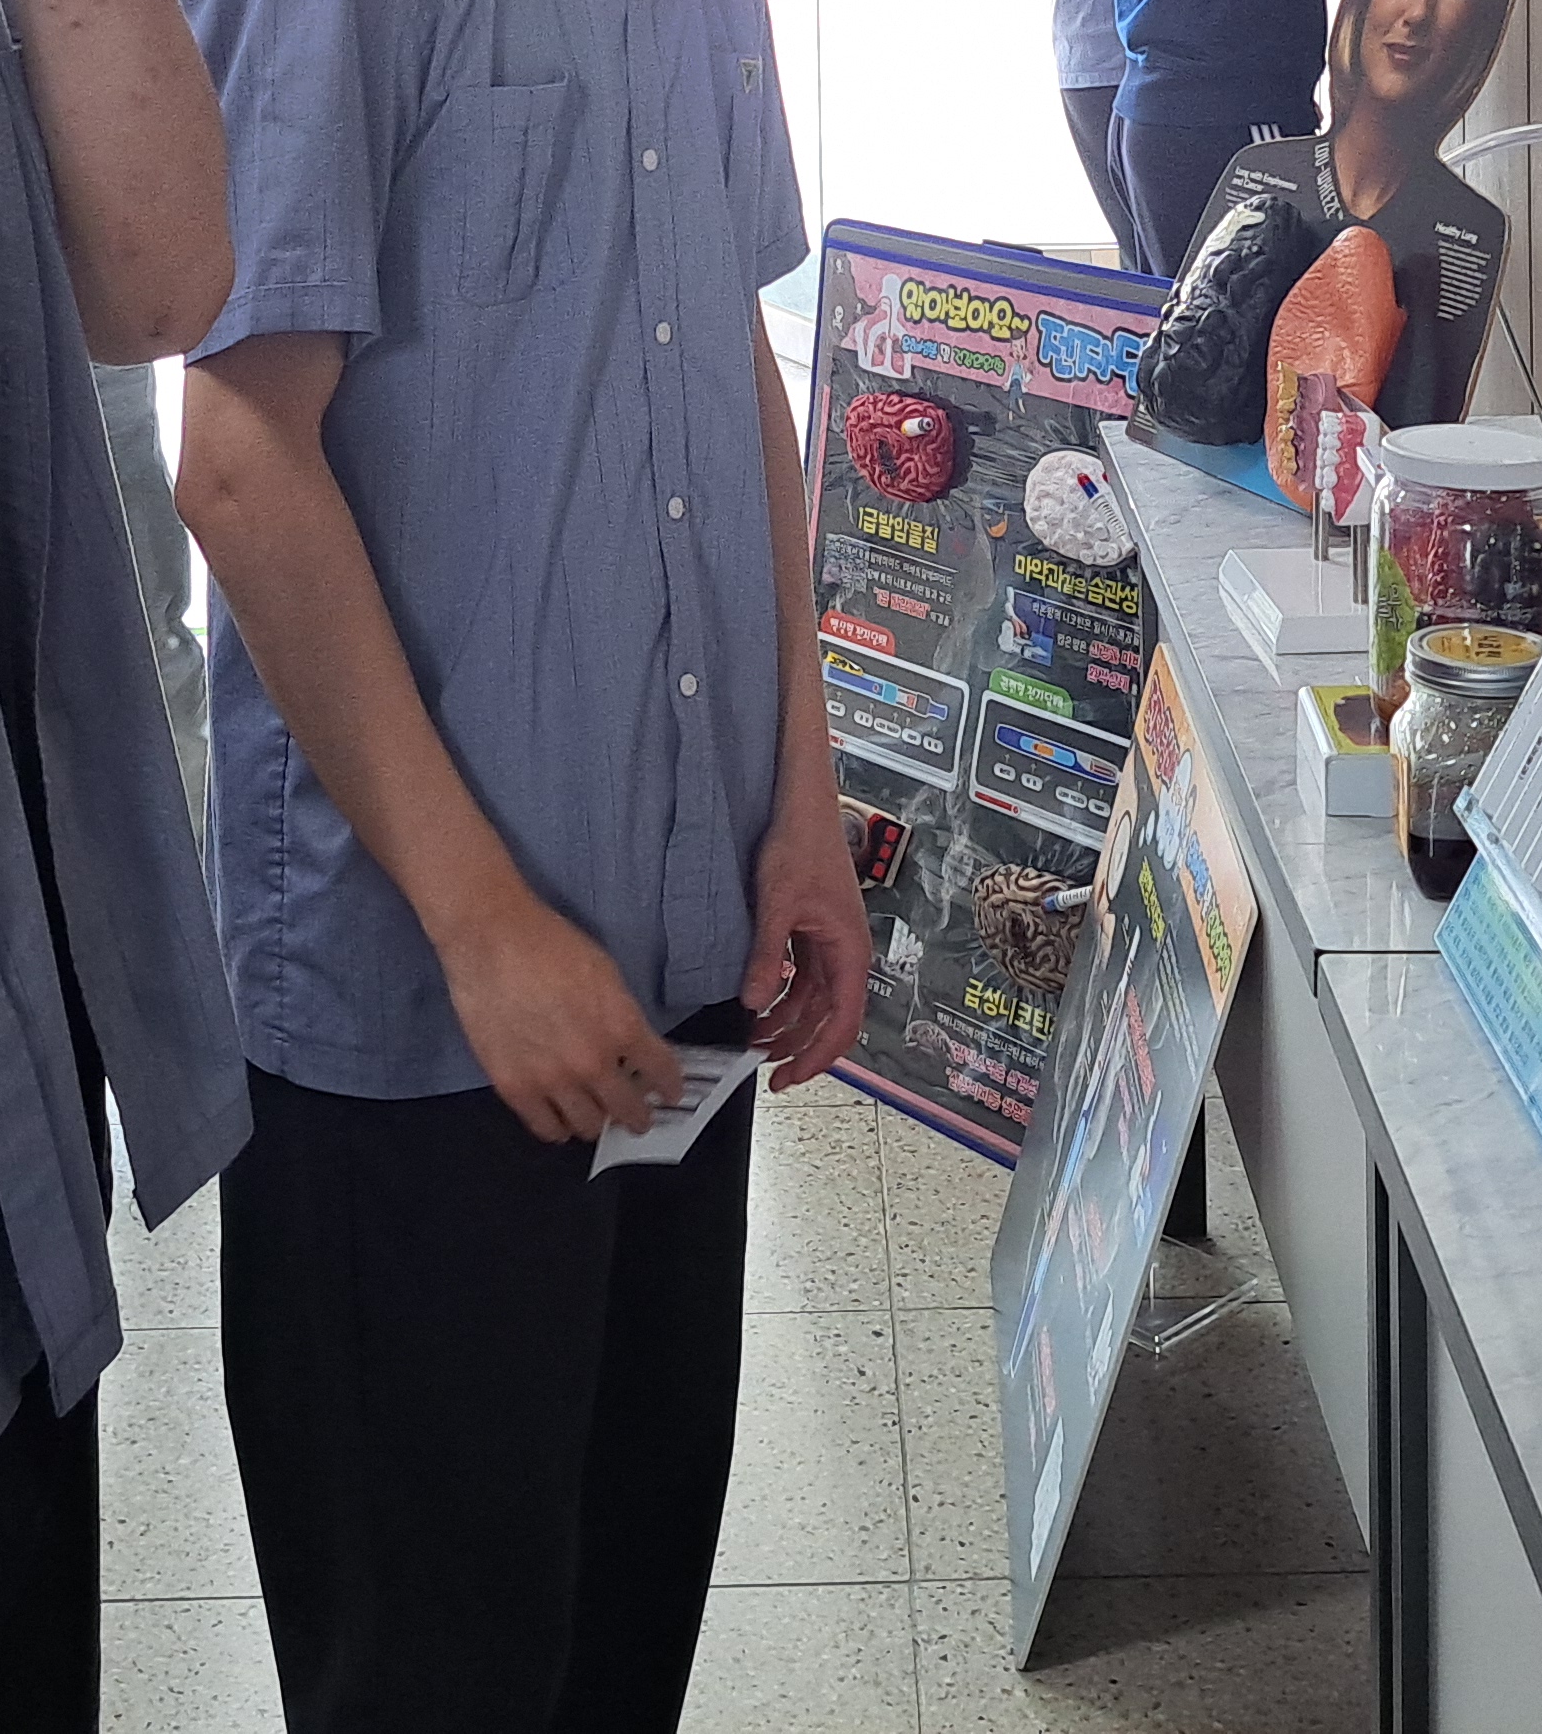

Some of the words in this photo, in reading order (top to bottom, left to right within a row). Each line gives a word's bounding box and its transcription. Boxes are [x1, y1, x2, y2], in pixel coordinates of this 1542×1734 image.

[899, 279, 1031, 340] 알아보아요~
[1087, 576, 1139, 615] 습관성
[964, 977, 1056, 1042] 급성니코틴
